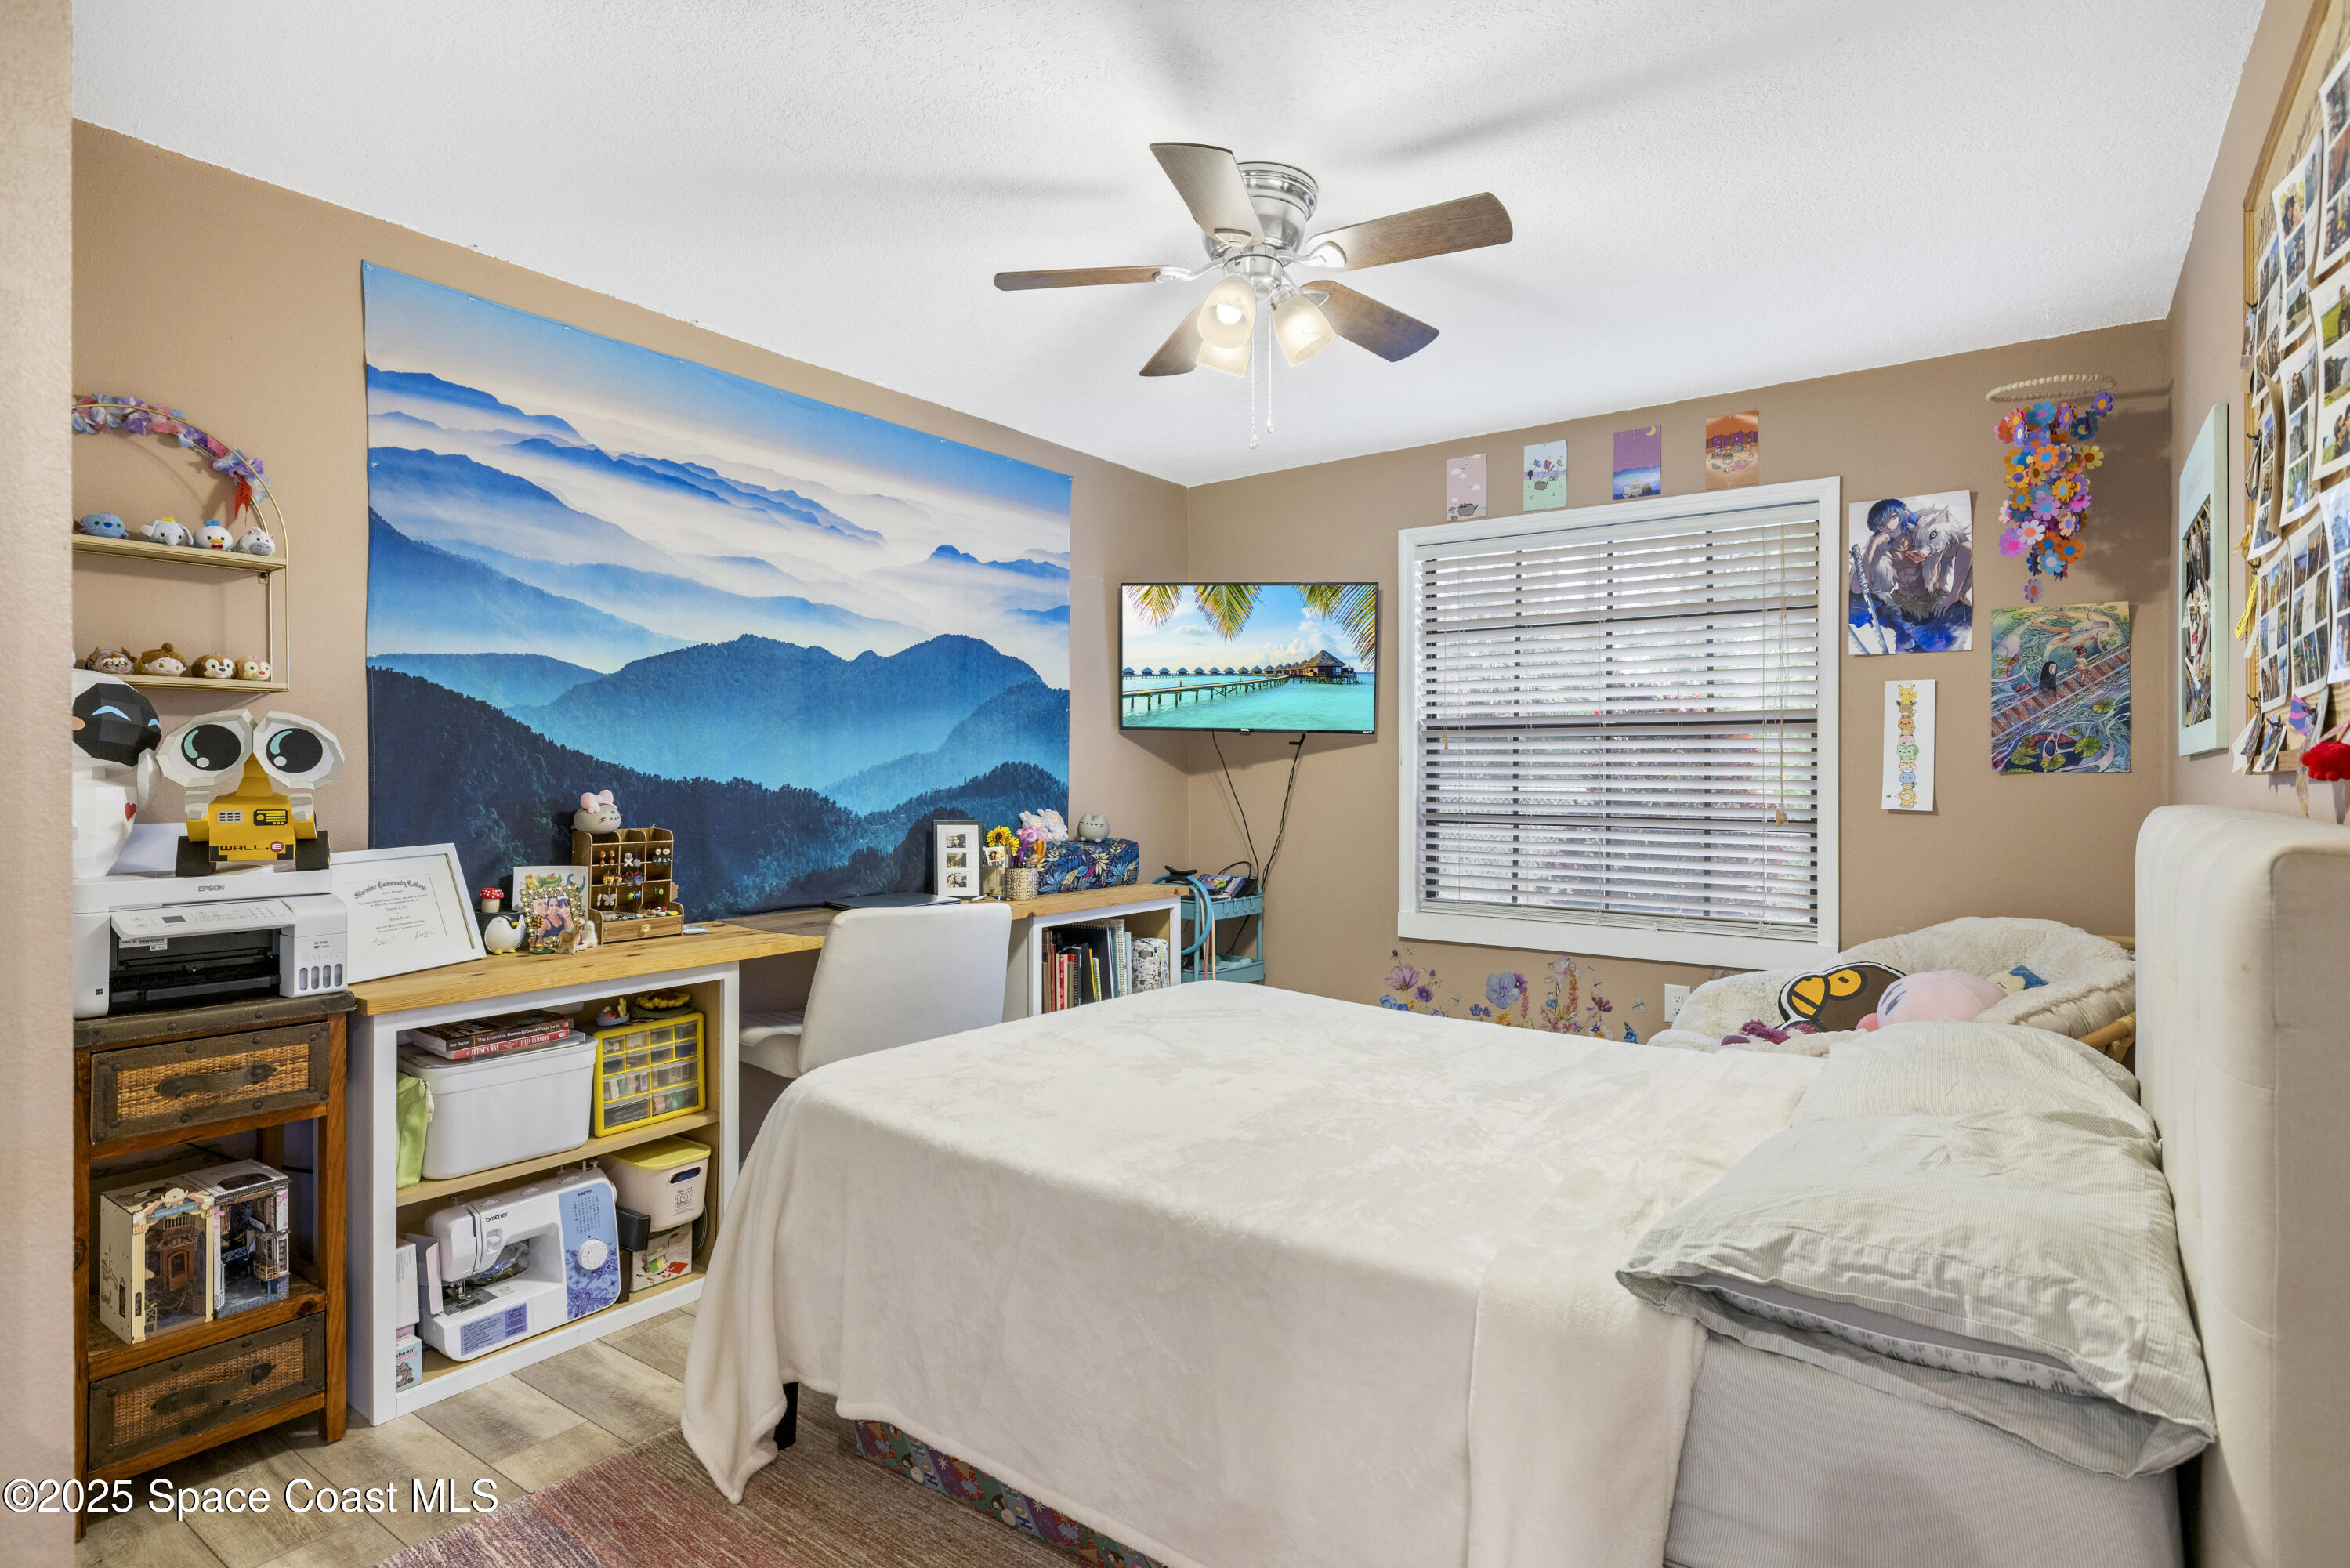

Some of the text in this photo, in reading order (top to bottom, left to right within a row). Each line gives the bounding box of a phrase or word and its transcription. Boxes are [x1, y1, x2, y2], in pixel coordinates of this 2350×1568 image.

[354, 885, 377, 900] Shoreline
[377, 879, 407, 889] Community
[407, 879, 427, 891] College
[506, 1027, 538, 1037] Home-Ground
[471, 1046, 490, 1056] ARTIST'S
[531, 1035, 549, 1044] CAMERON
[676, 1190, 694, 1204] TOY
[486, 1212, 508, 1222] brother
